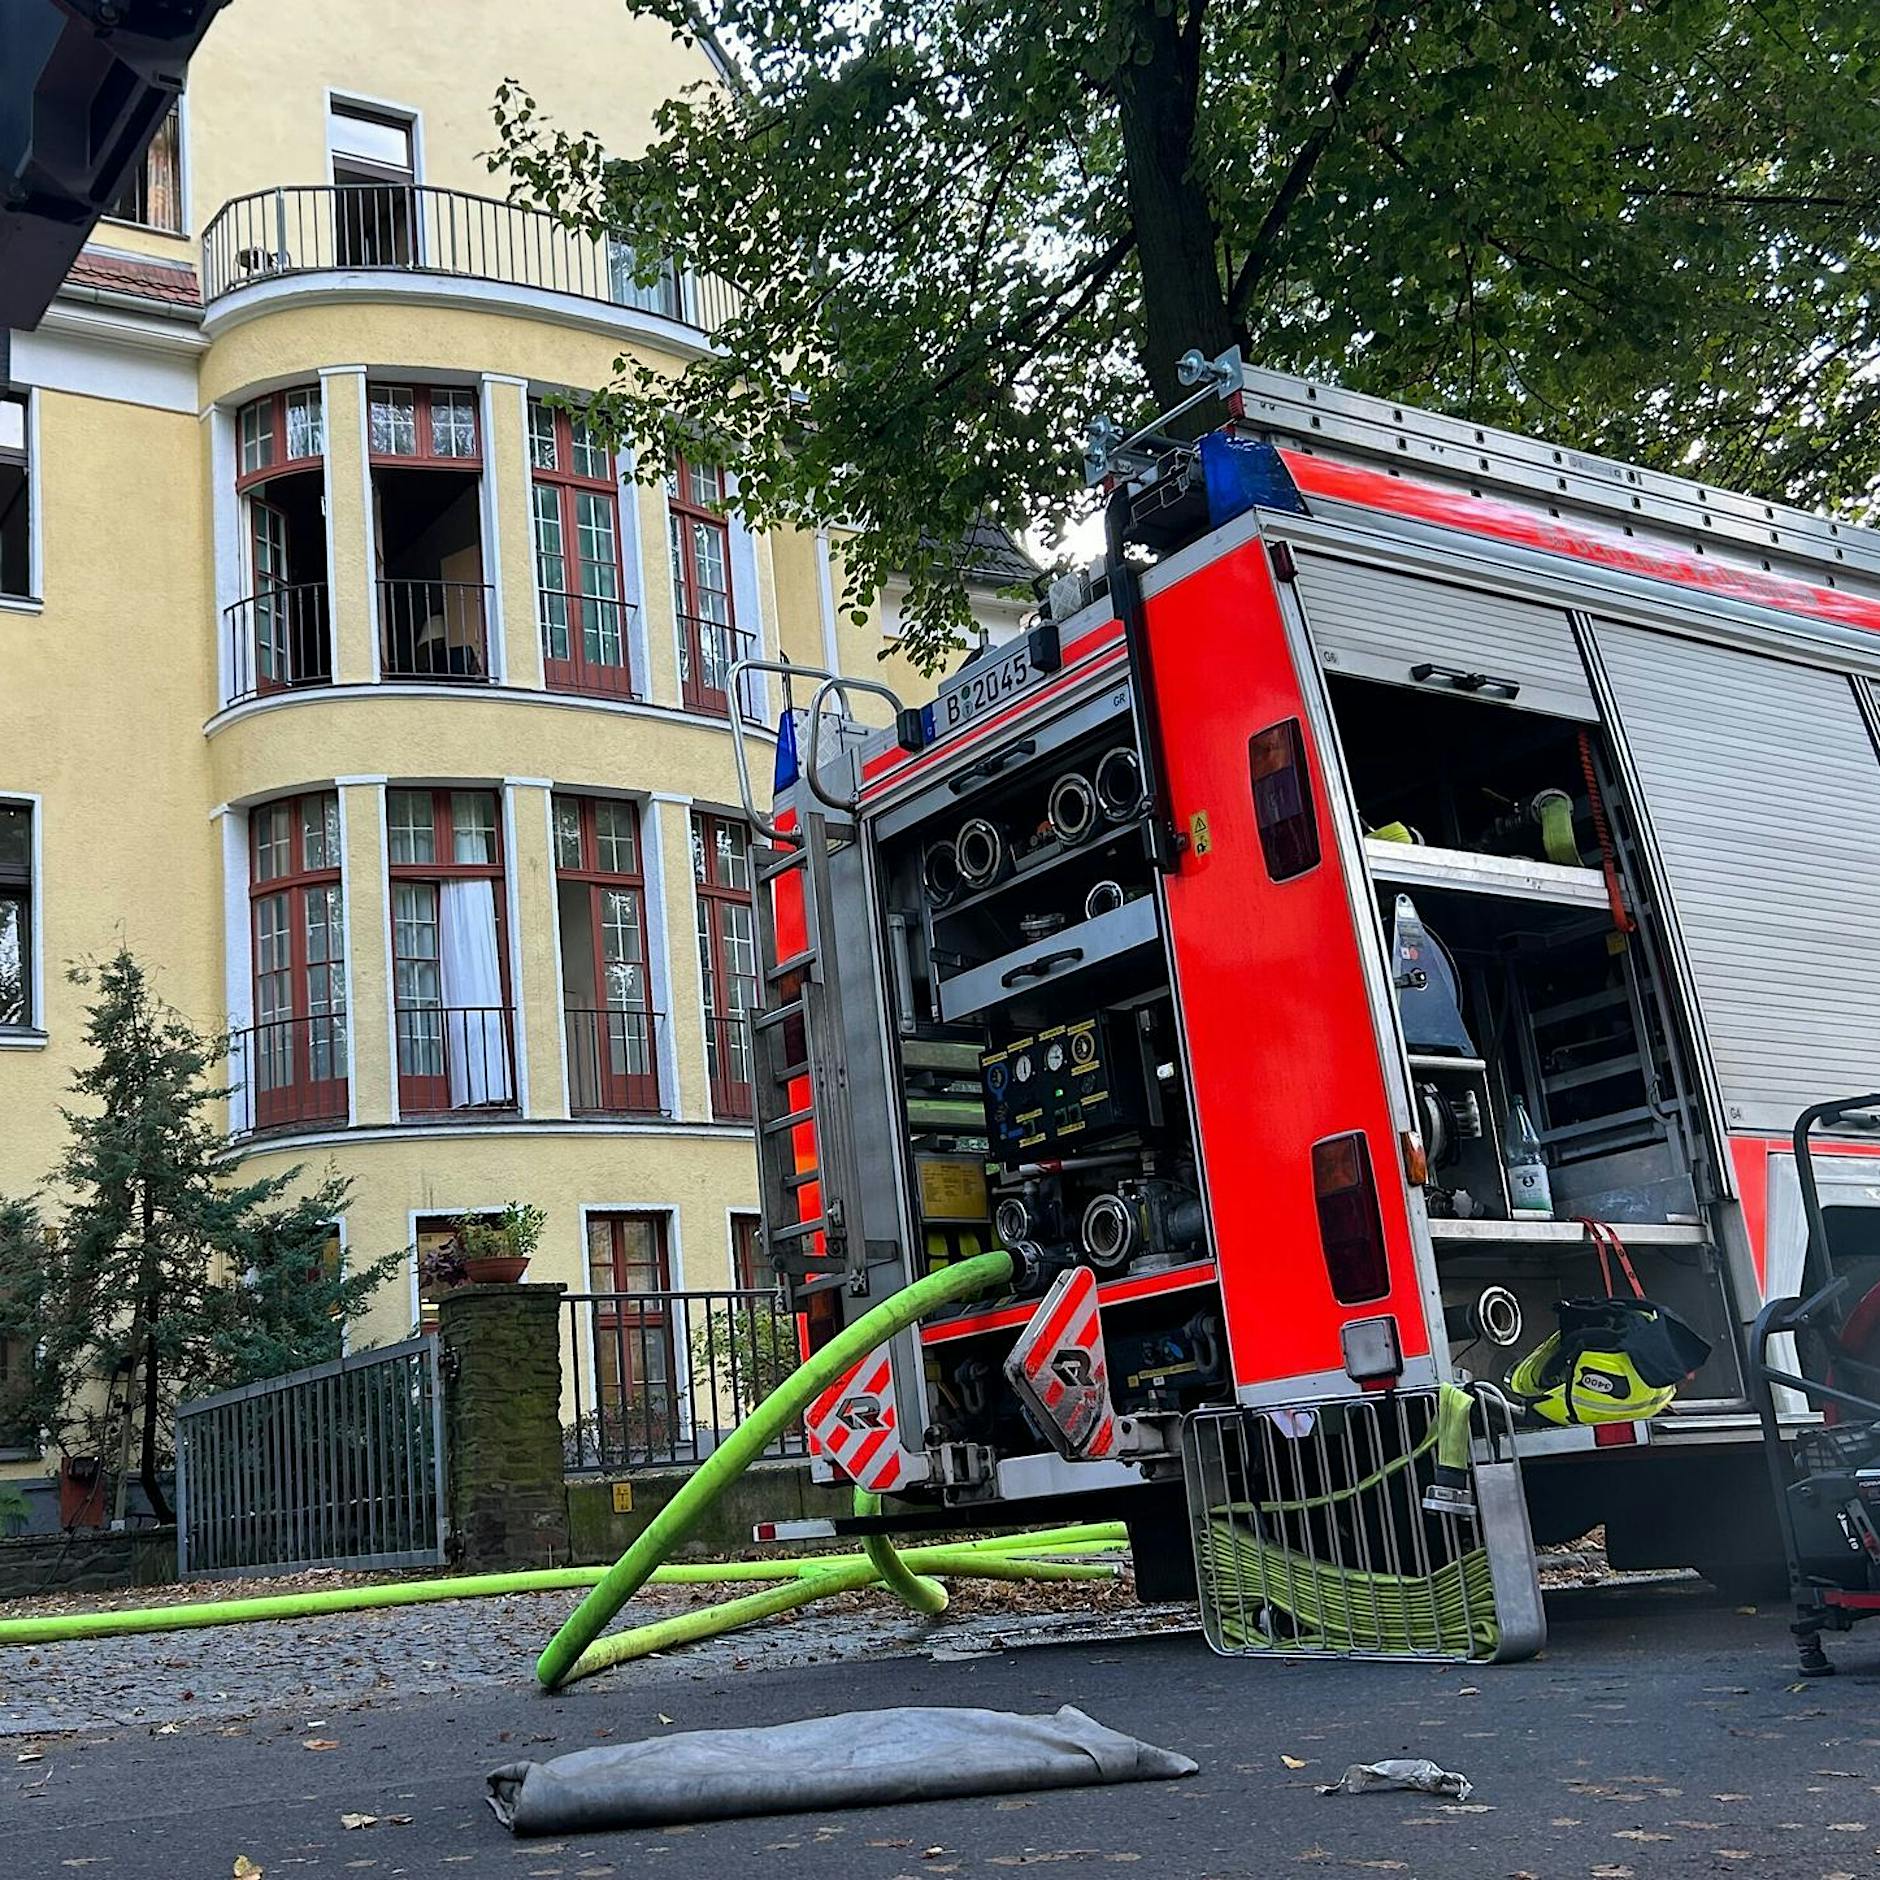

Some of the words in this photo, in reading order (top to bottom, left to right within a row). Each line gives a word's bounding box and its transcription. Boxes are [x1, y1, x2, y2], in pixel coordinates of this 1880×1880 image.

[946, 695, 960, 724] B
[972, 653, 1027, 710] 2045
[1113, 692, 1126, 707] GR
[1584, 1376, 1611, 1390] 3400
